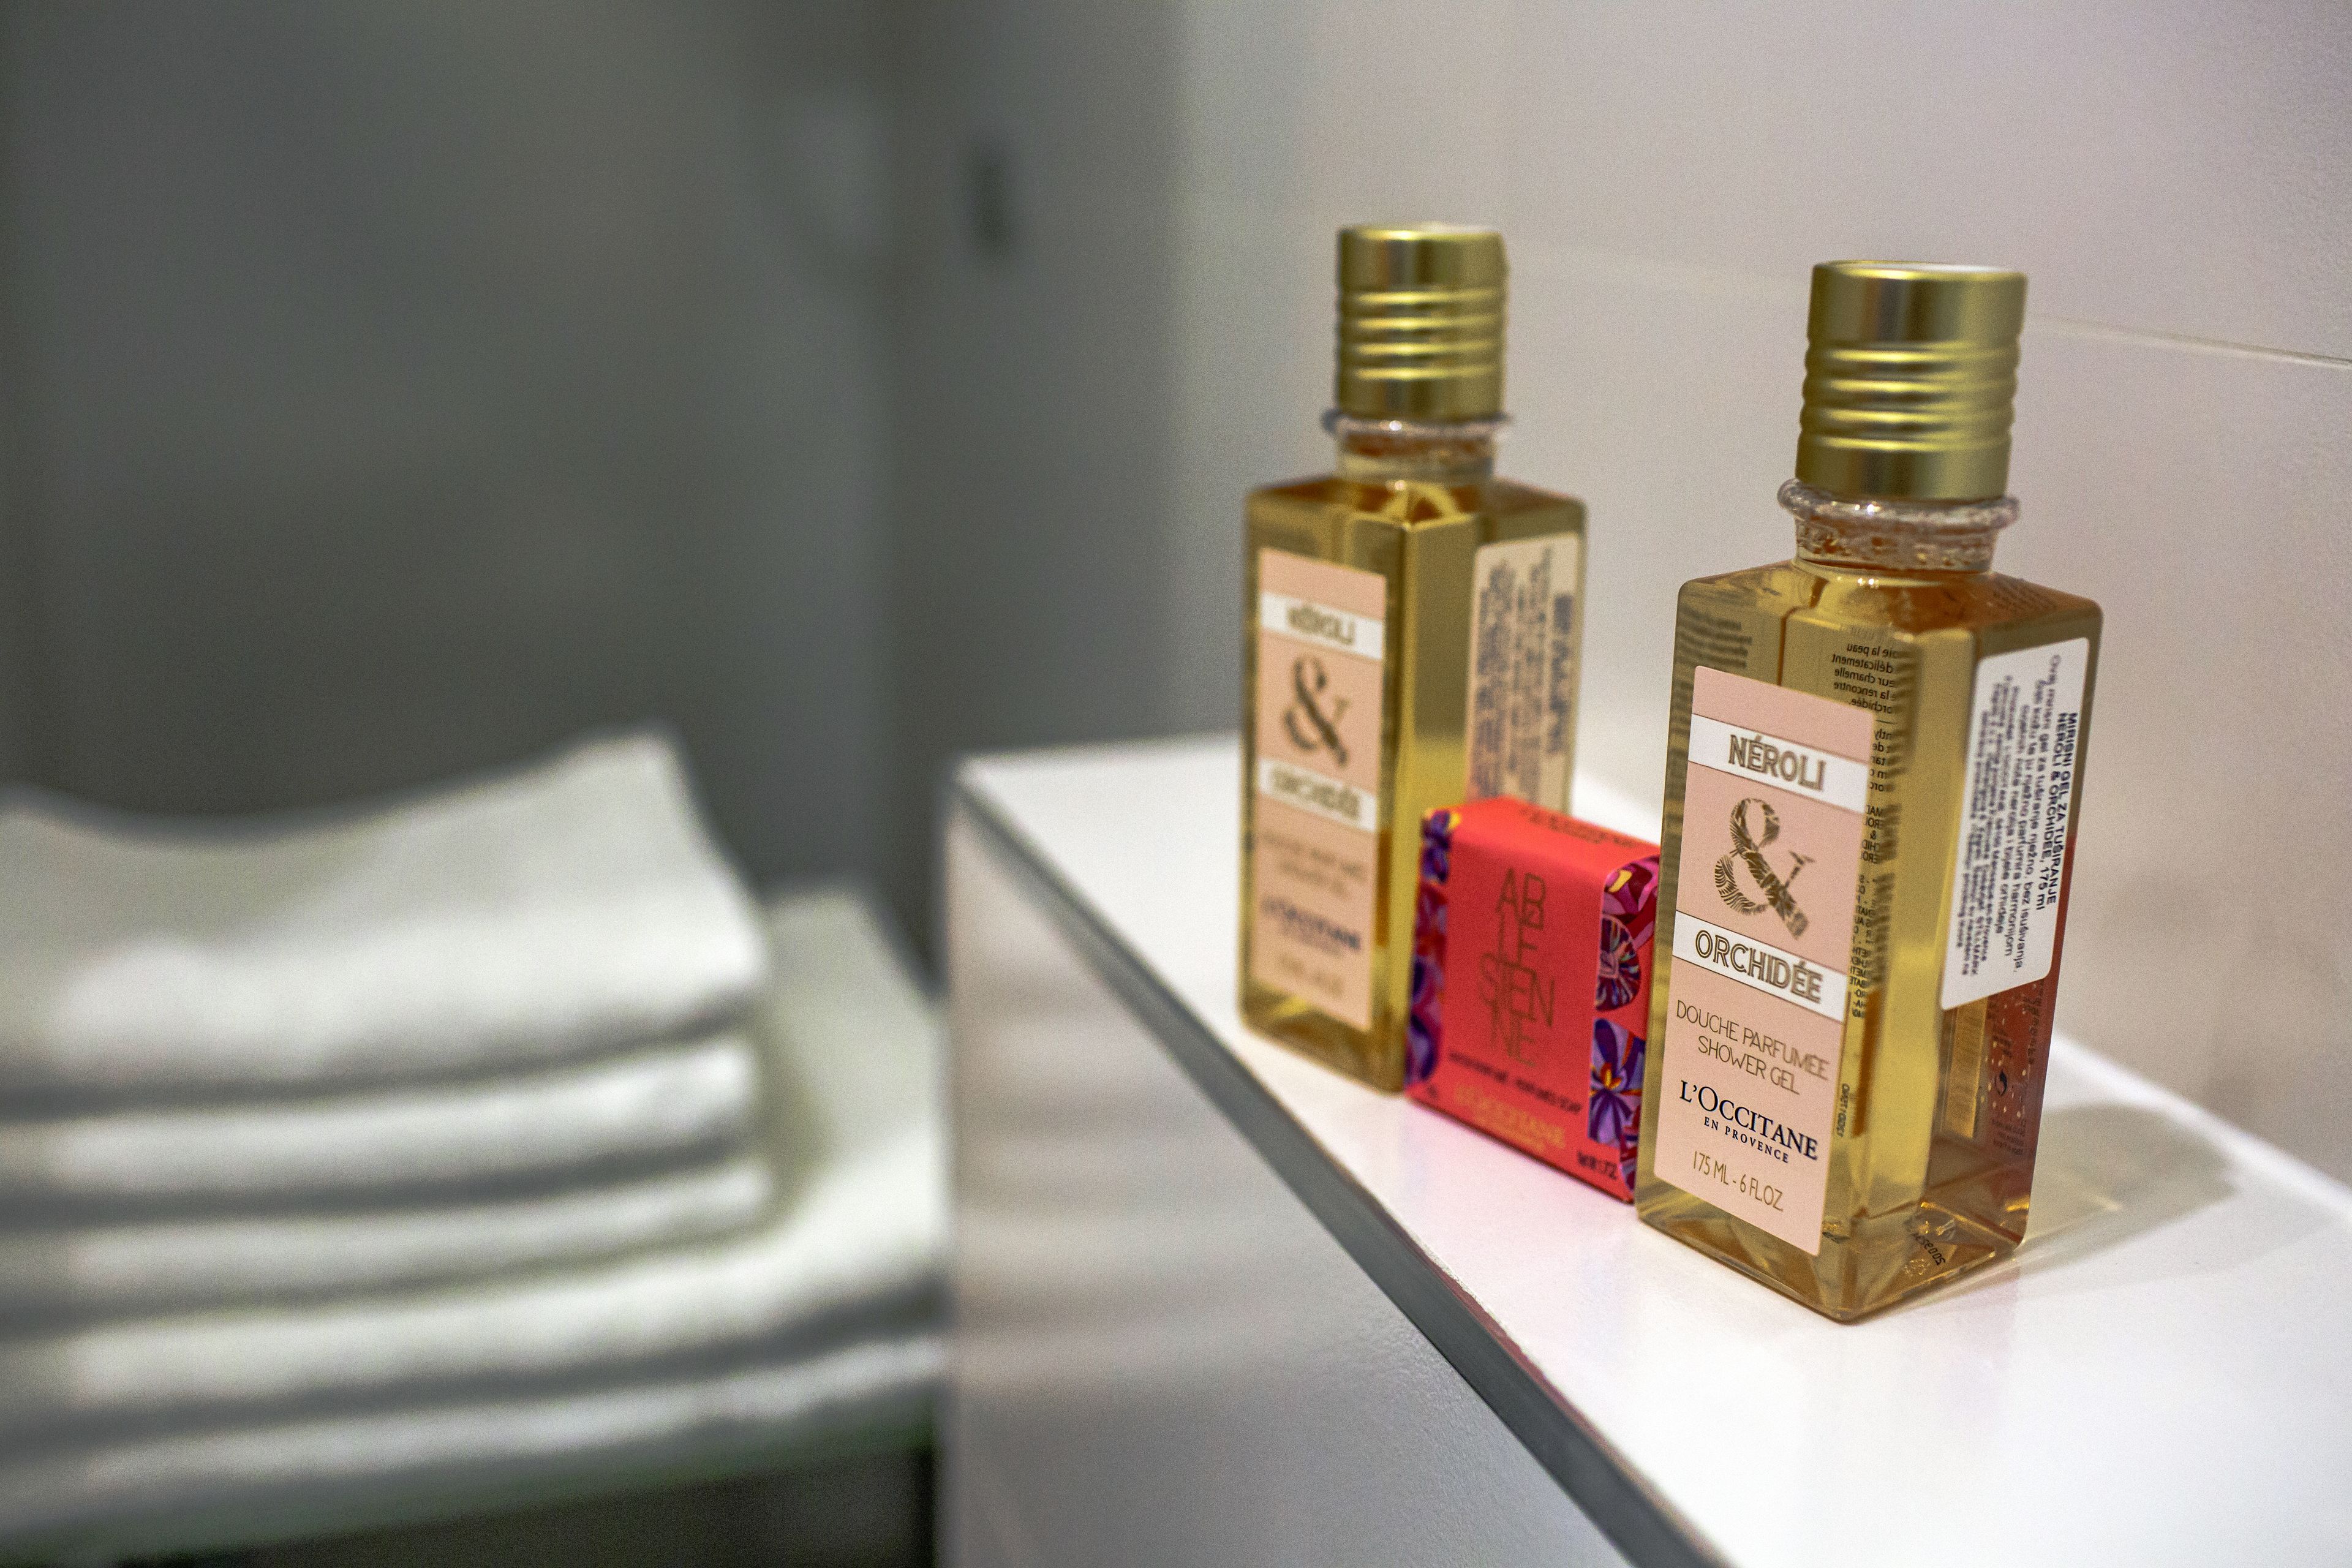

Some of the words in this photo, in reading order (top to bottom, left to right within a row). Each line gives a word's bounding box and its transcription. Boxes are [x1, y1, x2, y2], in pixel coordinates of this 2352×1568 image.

[1728, 734, 1827, 792] NÉROLI
[2052, 712, 2068, 767] NEROLI
[2062, 711, 2079, 767] MIRISNI
[2056, 802, 2067, 822] ZA
[2058, 769, 2071, 801] GEL
[1715, 798, 1814, 940] &
[2038, 866, 2049, 891] 175
[2046, 824, 2065, 905] TUŠIRANJE
[2021, 880, 2034, 905] bez
[2035, 892, 2046, 911] ml
[1695, 929, 1823, 1004] ORCHIDÉE
[1676, 1000, 1740, 1042] DOUCHE
[1743, 1027, 1830, 1081] PARFUMÉE
[1698, 1036, 1766, 1080] SHOWER
[1770, 1066, 1800, 1095] GEL
[1703, 1117, 1719, 1131] EN
[1725, 1125, 1789, 1164] PROVENCE
[1693, 1151, 1711, 1176] 175
[1714, 1161, 1730, 1186] ML
[1740, 1174, 1747, 1194] 6
